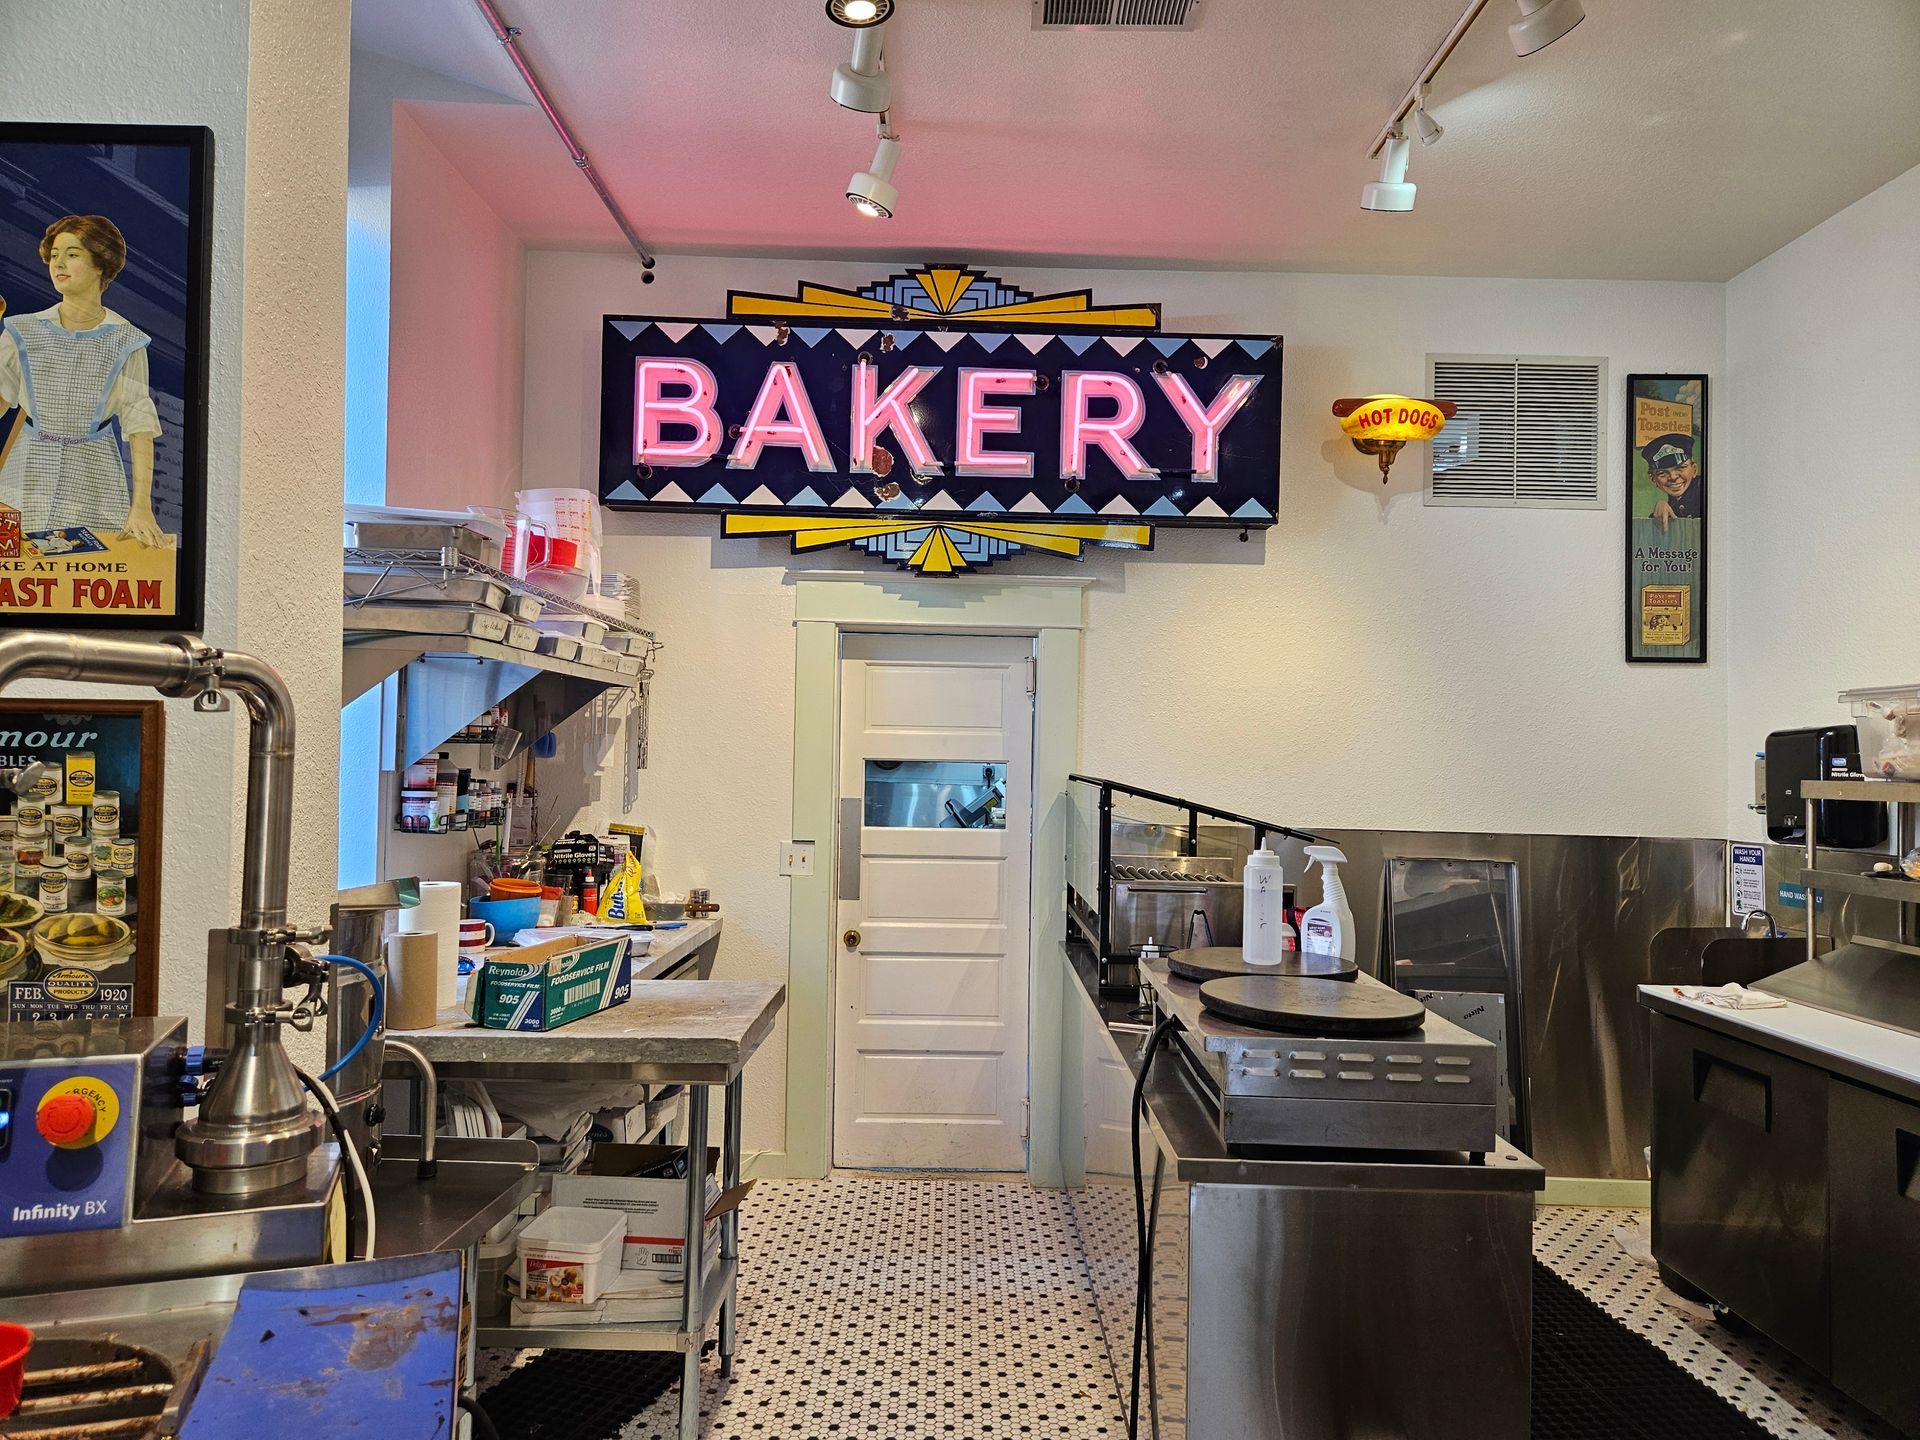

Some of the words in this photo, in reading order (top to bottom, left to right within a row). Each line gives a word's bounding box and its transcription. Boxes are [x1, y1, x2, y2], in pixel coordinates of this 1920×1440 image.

[1640, 401, 1670, 417] Post
[634, 355, 1265, 482] BAKERY
[1358, 408, 1393, 429] HOT
[1398, 408, 1439, 429] DOGS
[1638, 416, 1691, 432] Toasties
[1635, 547, 1645, 558] A
[1649, 547, 1698, 562] Message
[32, 561, 58, 572] AT
[66, 562, 128, 573] HOME
[1641, 561, 1660, 572] for
[1664, 561, 1691, 572] You!
[72, 578, 162, 609] FOAM
[1734, 848, 1748, 856] WASH
[1748, 849, 1761, 857] YOUR
[1779, 890, 1794, 899] HAND
[1794, 892, 1807, 901] WAS
[488, 965, 528, 977] Reynolds
[550, 965, 595, 987] FOODSERVICE
[594, 961, 610, 973] FILM
[490, 980, 526, 988] FOODSERVICE
[15, 987, 45, 1000] FEB.
[101, 989, 128, 1002] 1920
[499, 994, 520, 1004] 905
[615, 984, 630, 1000] 905
[17, 1012, 21, 1021] 1
[32, 1012, 41, 1021] 2
[50, 1012, 57, 1021] 3
[1463, 1005, 1485, 1020] Nitto
[65, 1087, 107, 1113] RGENCY
[12, 1203, 81, 1222] Infinity
[84, 1200, 108, 1216] BX
